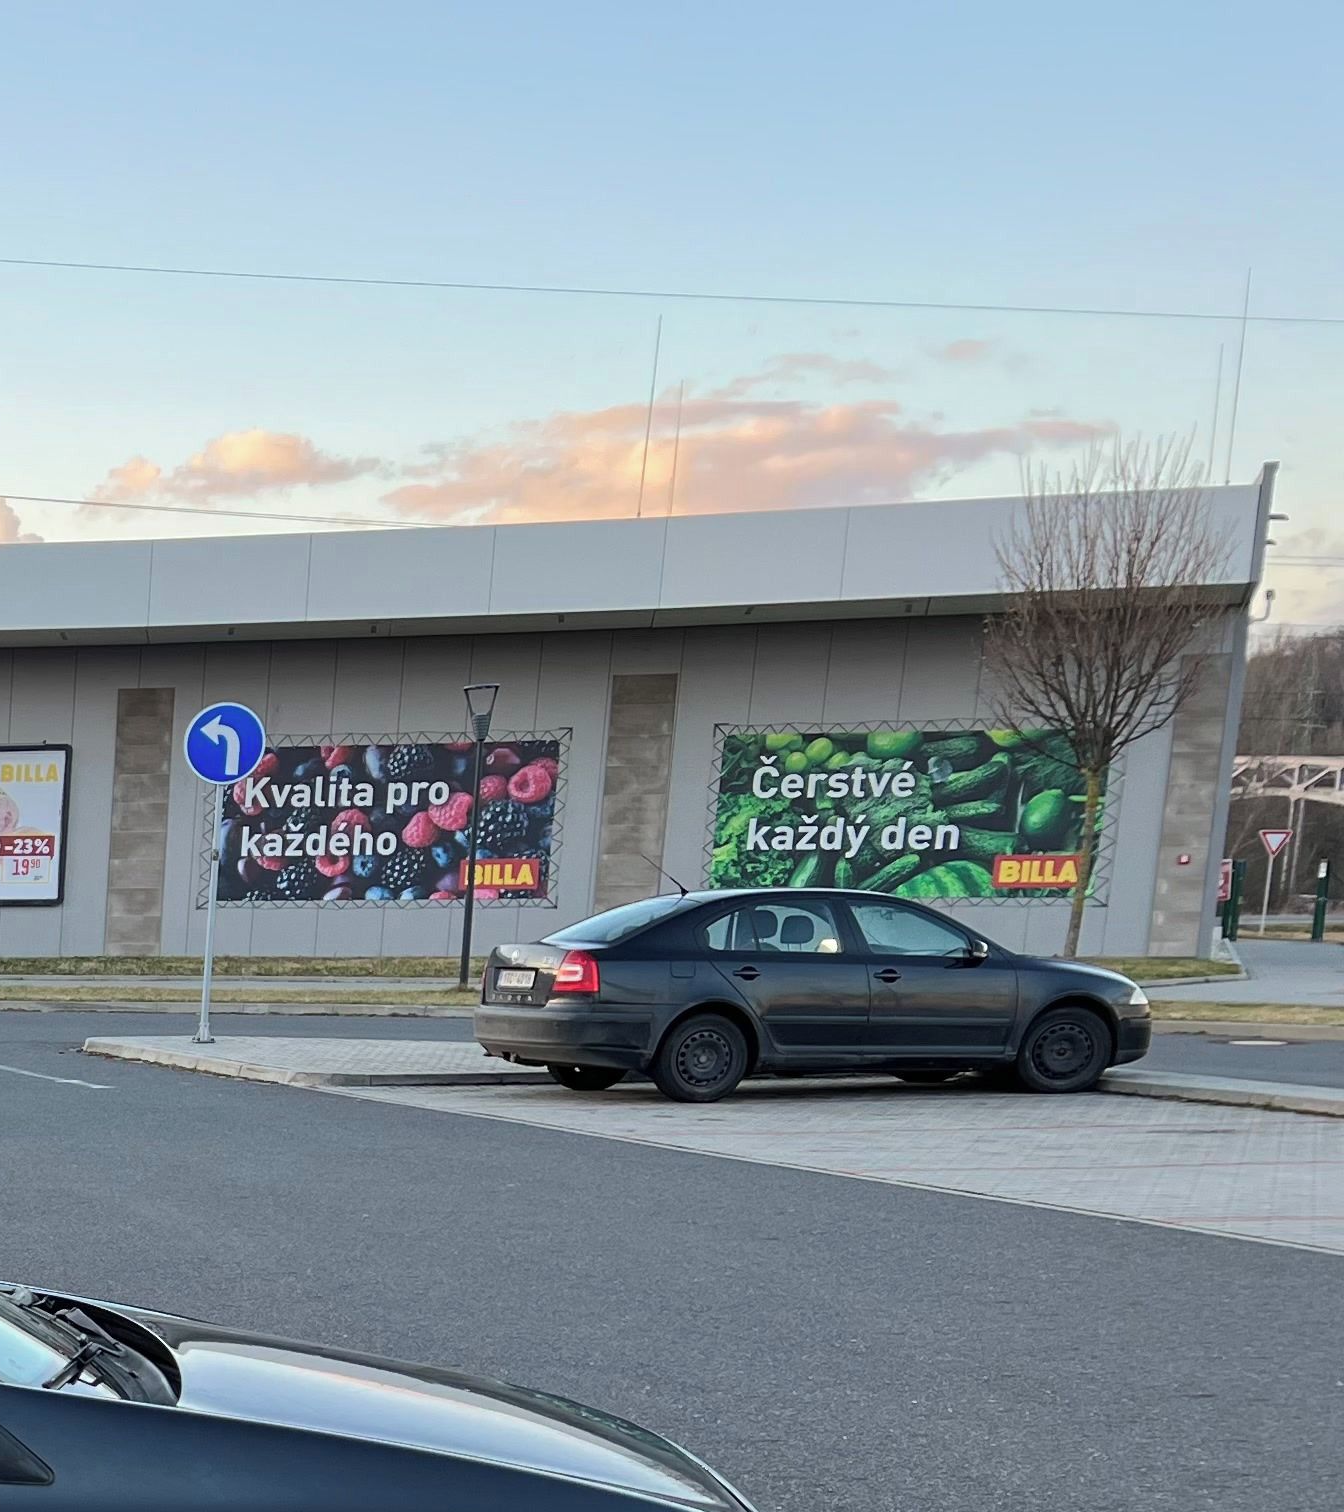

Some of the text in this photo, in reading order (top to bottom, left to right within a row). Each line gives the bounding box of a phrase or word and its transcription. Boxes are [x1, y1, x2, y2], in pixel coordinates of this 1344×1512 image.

[1, 763, 59, 782] BILLA
[752, 755, 916, 799] Čerstvé
[244, 775, 450, 814] Kvalita pro
[4, 838, 50, 854] -23%
[240, 823, 397, 858] každého
[746, 814, 960, 859] každý den
[464, 863, 534, 886] BILLA
[998, 861, 1078, 883] BILLA
